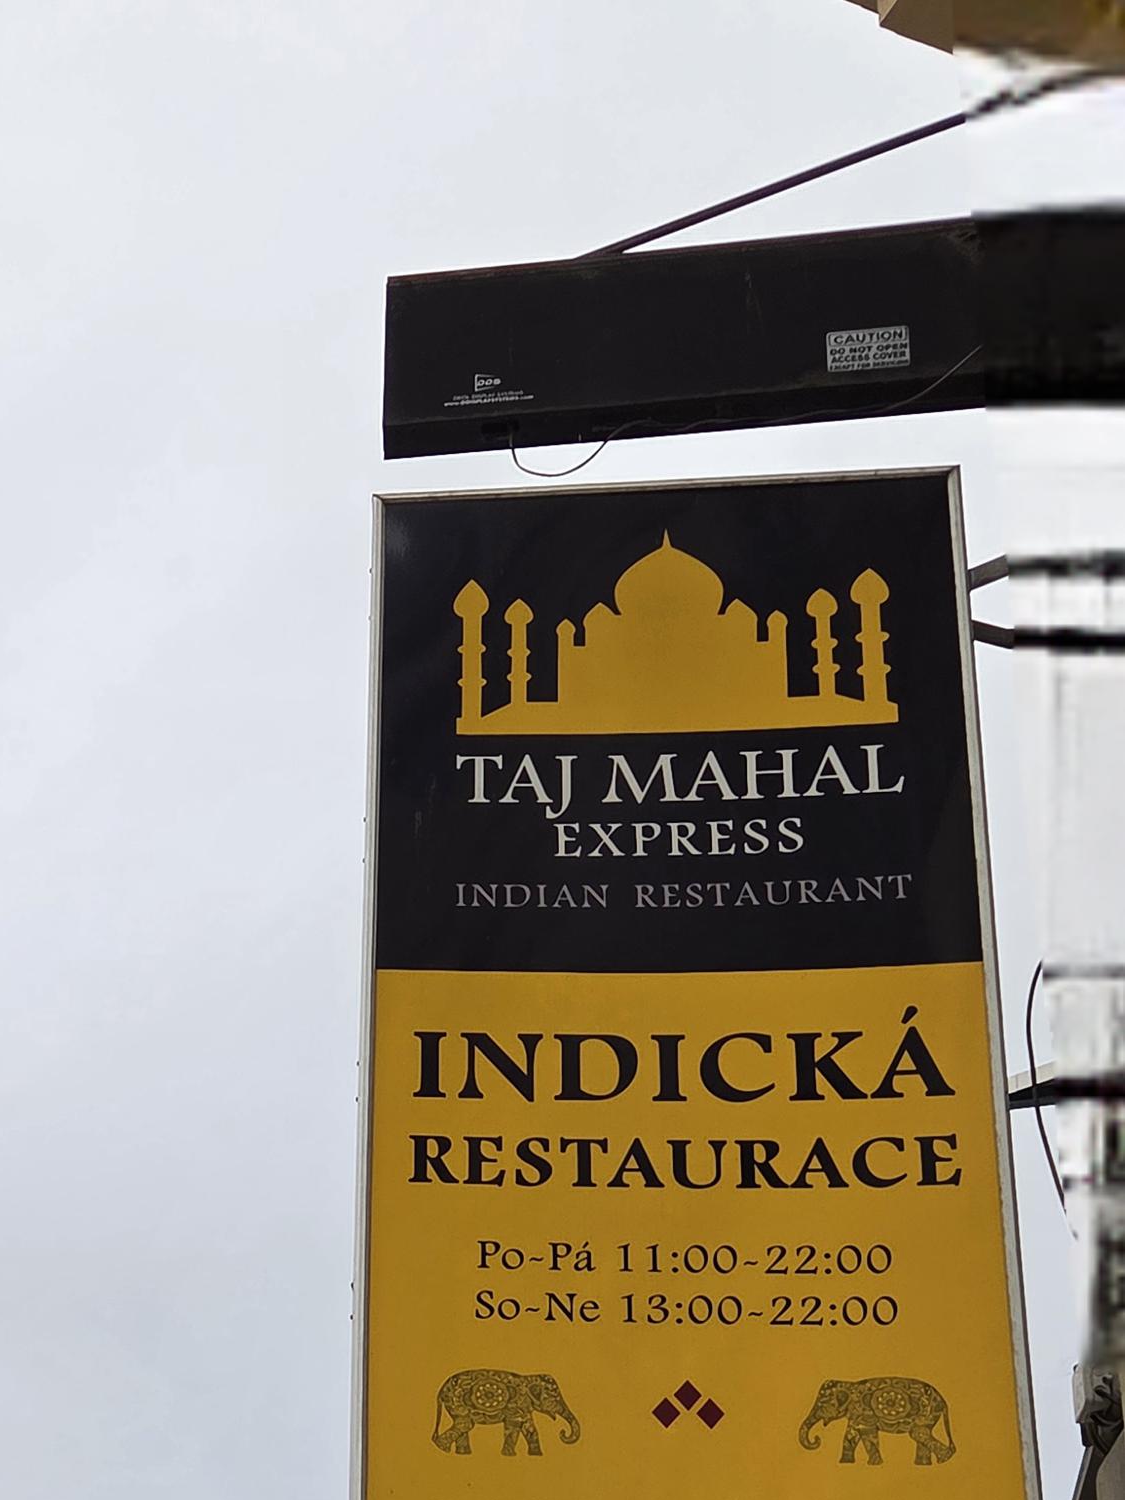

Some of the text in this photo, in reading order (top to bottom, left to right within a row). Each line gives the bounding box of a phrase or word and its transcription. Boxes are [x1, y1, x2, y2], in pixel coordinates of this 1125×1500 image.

[830, 342, 908, 356] DO NOT OPEN
[834, 330, 903, 345] CAUTION
[831, 353, 870, 363] ACCESS
[873, 350, 907, 361] COVER
[457, 745, 904, 819] TAJ MAHAL
[554, 816, 804, 858] EXPRESS
[457, 875, 911, 907] INDIAN RESTAURANT
[413, 1006, 955, 1102] INDICKÁ
[408, 1134, 961, 1189] RESTAURACE
[478, 1241, 891, 1274] Po-Pá 11:00-22:00
[476, 1291, 897, 1325] So-Ne 13:00-22:00
